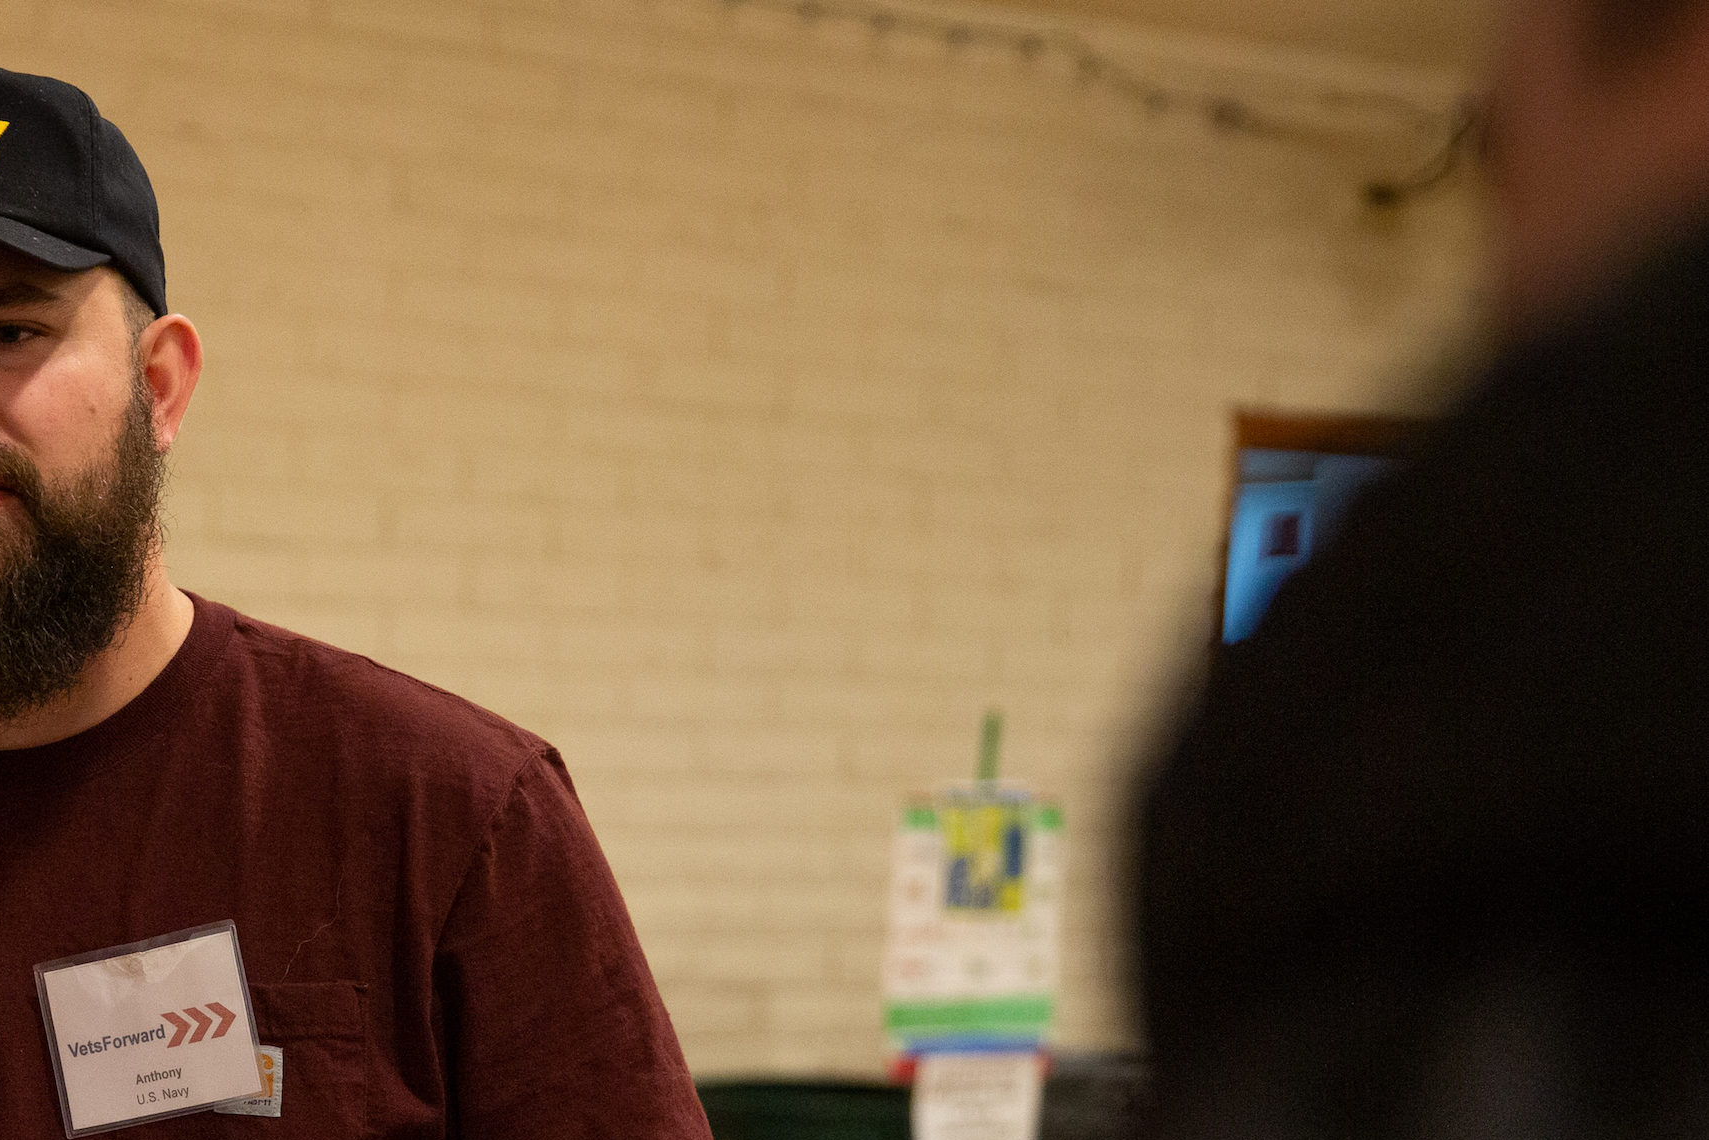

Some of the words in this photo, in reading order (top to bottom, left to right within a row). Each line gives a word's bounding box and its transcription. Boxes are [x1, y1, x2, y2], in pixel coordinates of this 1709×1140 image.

[67, 1024, 166, 1059] VetsForward
[135, 1068, 183, 1085] Anthony
[136, 1091, 160, 1105] U.S.
[162, 1086, 190, 1101] Navy
